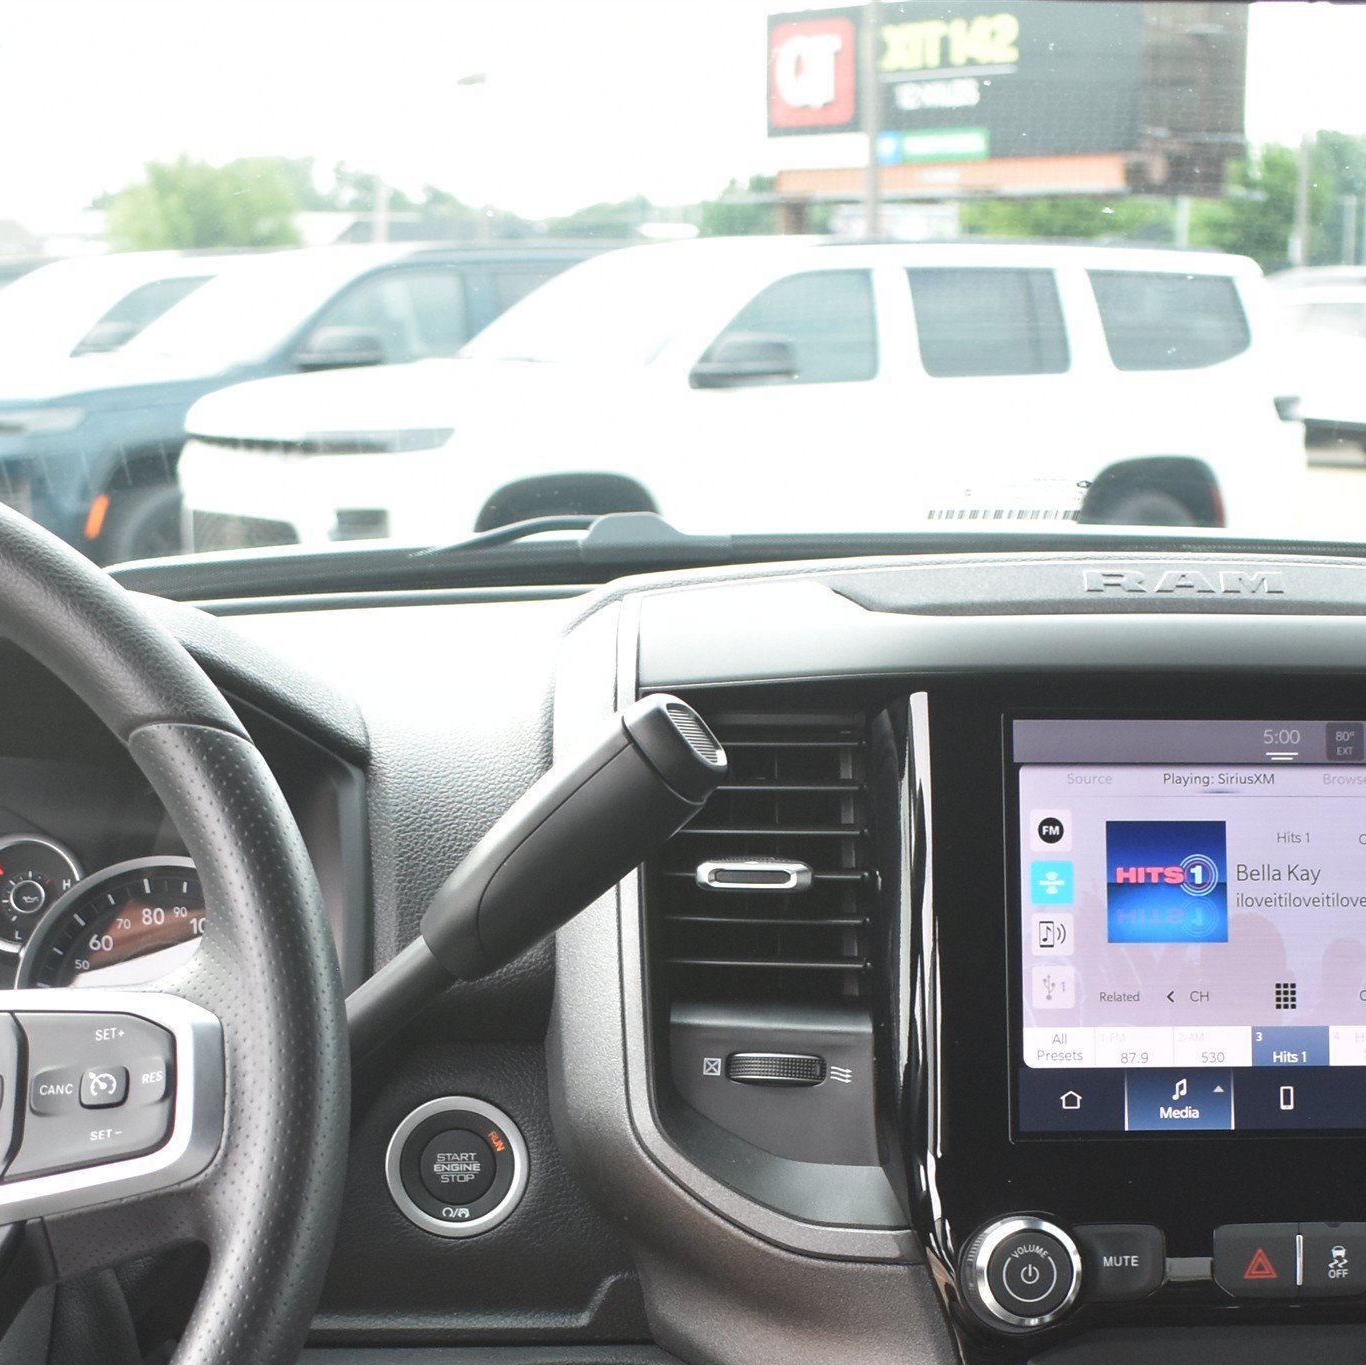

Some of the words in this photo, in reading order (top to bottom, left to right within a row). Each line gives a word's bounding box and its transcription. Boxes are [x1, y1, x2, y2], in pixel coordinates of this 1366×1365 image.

[878, 21, 948, 72] XIT
[1083, 569, 1285, 595] RAM
[1263, 729, 1300, 745] 5:00
[1336, 746, 1354, 756] EXT
[1066, 773, 1113, 785] Source
[1163, 773, 1215, 788] Playing:
[1218, 773, 1275, 785] SiriusXM
[1042, 825, 1060, 836] FM
[1276, 832, 1302, 844] Hits
[1305, 832, 1311, 843] 1
[1116, 866, 1185, 885] HITS
[1236, 864, 1282, 882] Bella
[1287, 864, 1321, 886] Kay
[63, 879, 71, 890] H
[142, 908, 165, 925] 80
[173, 907, 188, 918] 90
[116, 919, 131, 930] 70
[89, 935, 113, 951] 60
[75, 959, 90, 970] 50
[1099, 991, 1140, 1002] Related
[1189, 991, 1210, 1002] CH
[1052, 1033, 1068, 1045] All
[1255, 1032, 1263, 1042] 3
[1037, 1050, 1084, 1062] Presets
[1120, 1053, 1149, 1064] 87.9
[1201, 1052, 1225, 1064] 530
[1272, 1051, 1299, 1063] Hits
[1301, 1051, 1307, 1063] 1
[142, 1070, 163, 1084] RES
[39, 1084, 73, 1096] CANC
[1159, 1106, 1200, 1119] Media
[488, 1130, 506, 1152] RUN
[436, 1153, 477, 1162] START
[433, 1163, 481, 1172] ENGINE
[440, 1174, 475, 1183] STOP
[1011, 1244, 1049, 1259] VOLUME
[1103, 1255, 1139, 1267] MUTE
[1328, 1269, 1349, 1279] OFF
